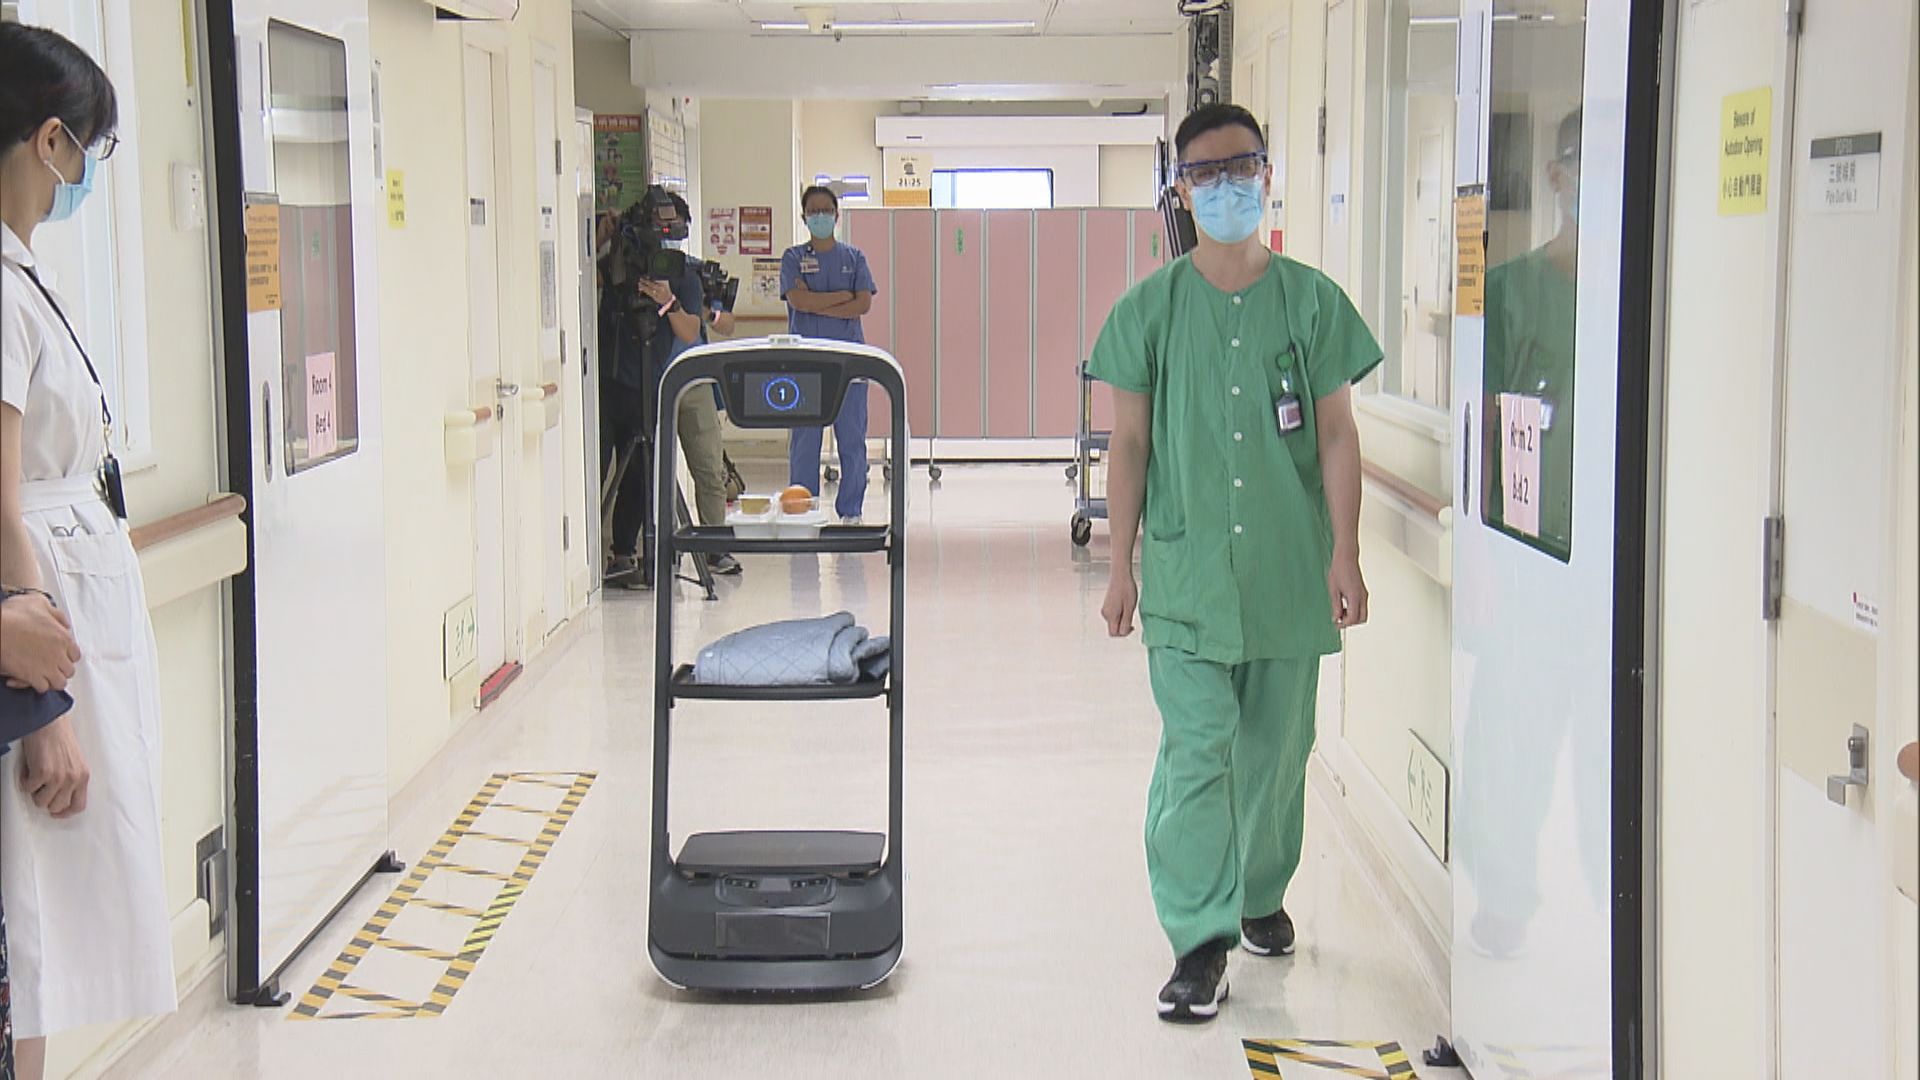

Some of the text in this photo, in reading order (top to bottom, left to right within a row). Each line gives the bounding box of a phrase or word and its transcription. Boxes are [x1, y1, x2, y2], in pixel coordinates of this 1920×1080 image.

[1733, 109, 1750, 128] Beware
[1744, 136, 1763, 157] Opening
[312, 374, 328, 395] Room
[779, 387, 785, 401] 1
[315, 410, 326, 434] Bed
[1510, 421, 1533, 452] Rm 2
[1524, 477, 1529, 505] 2
